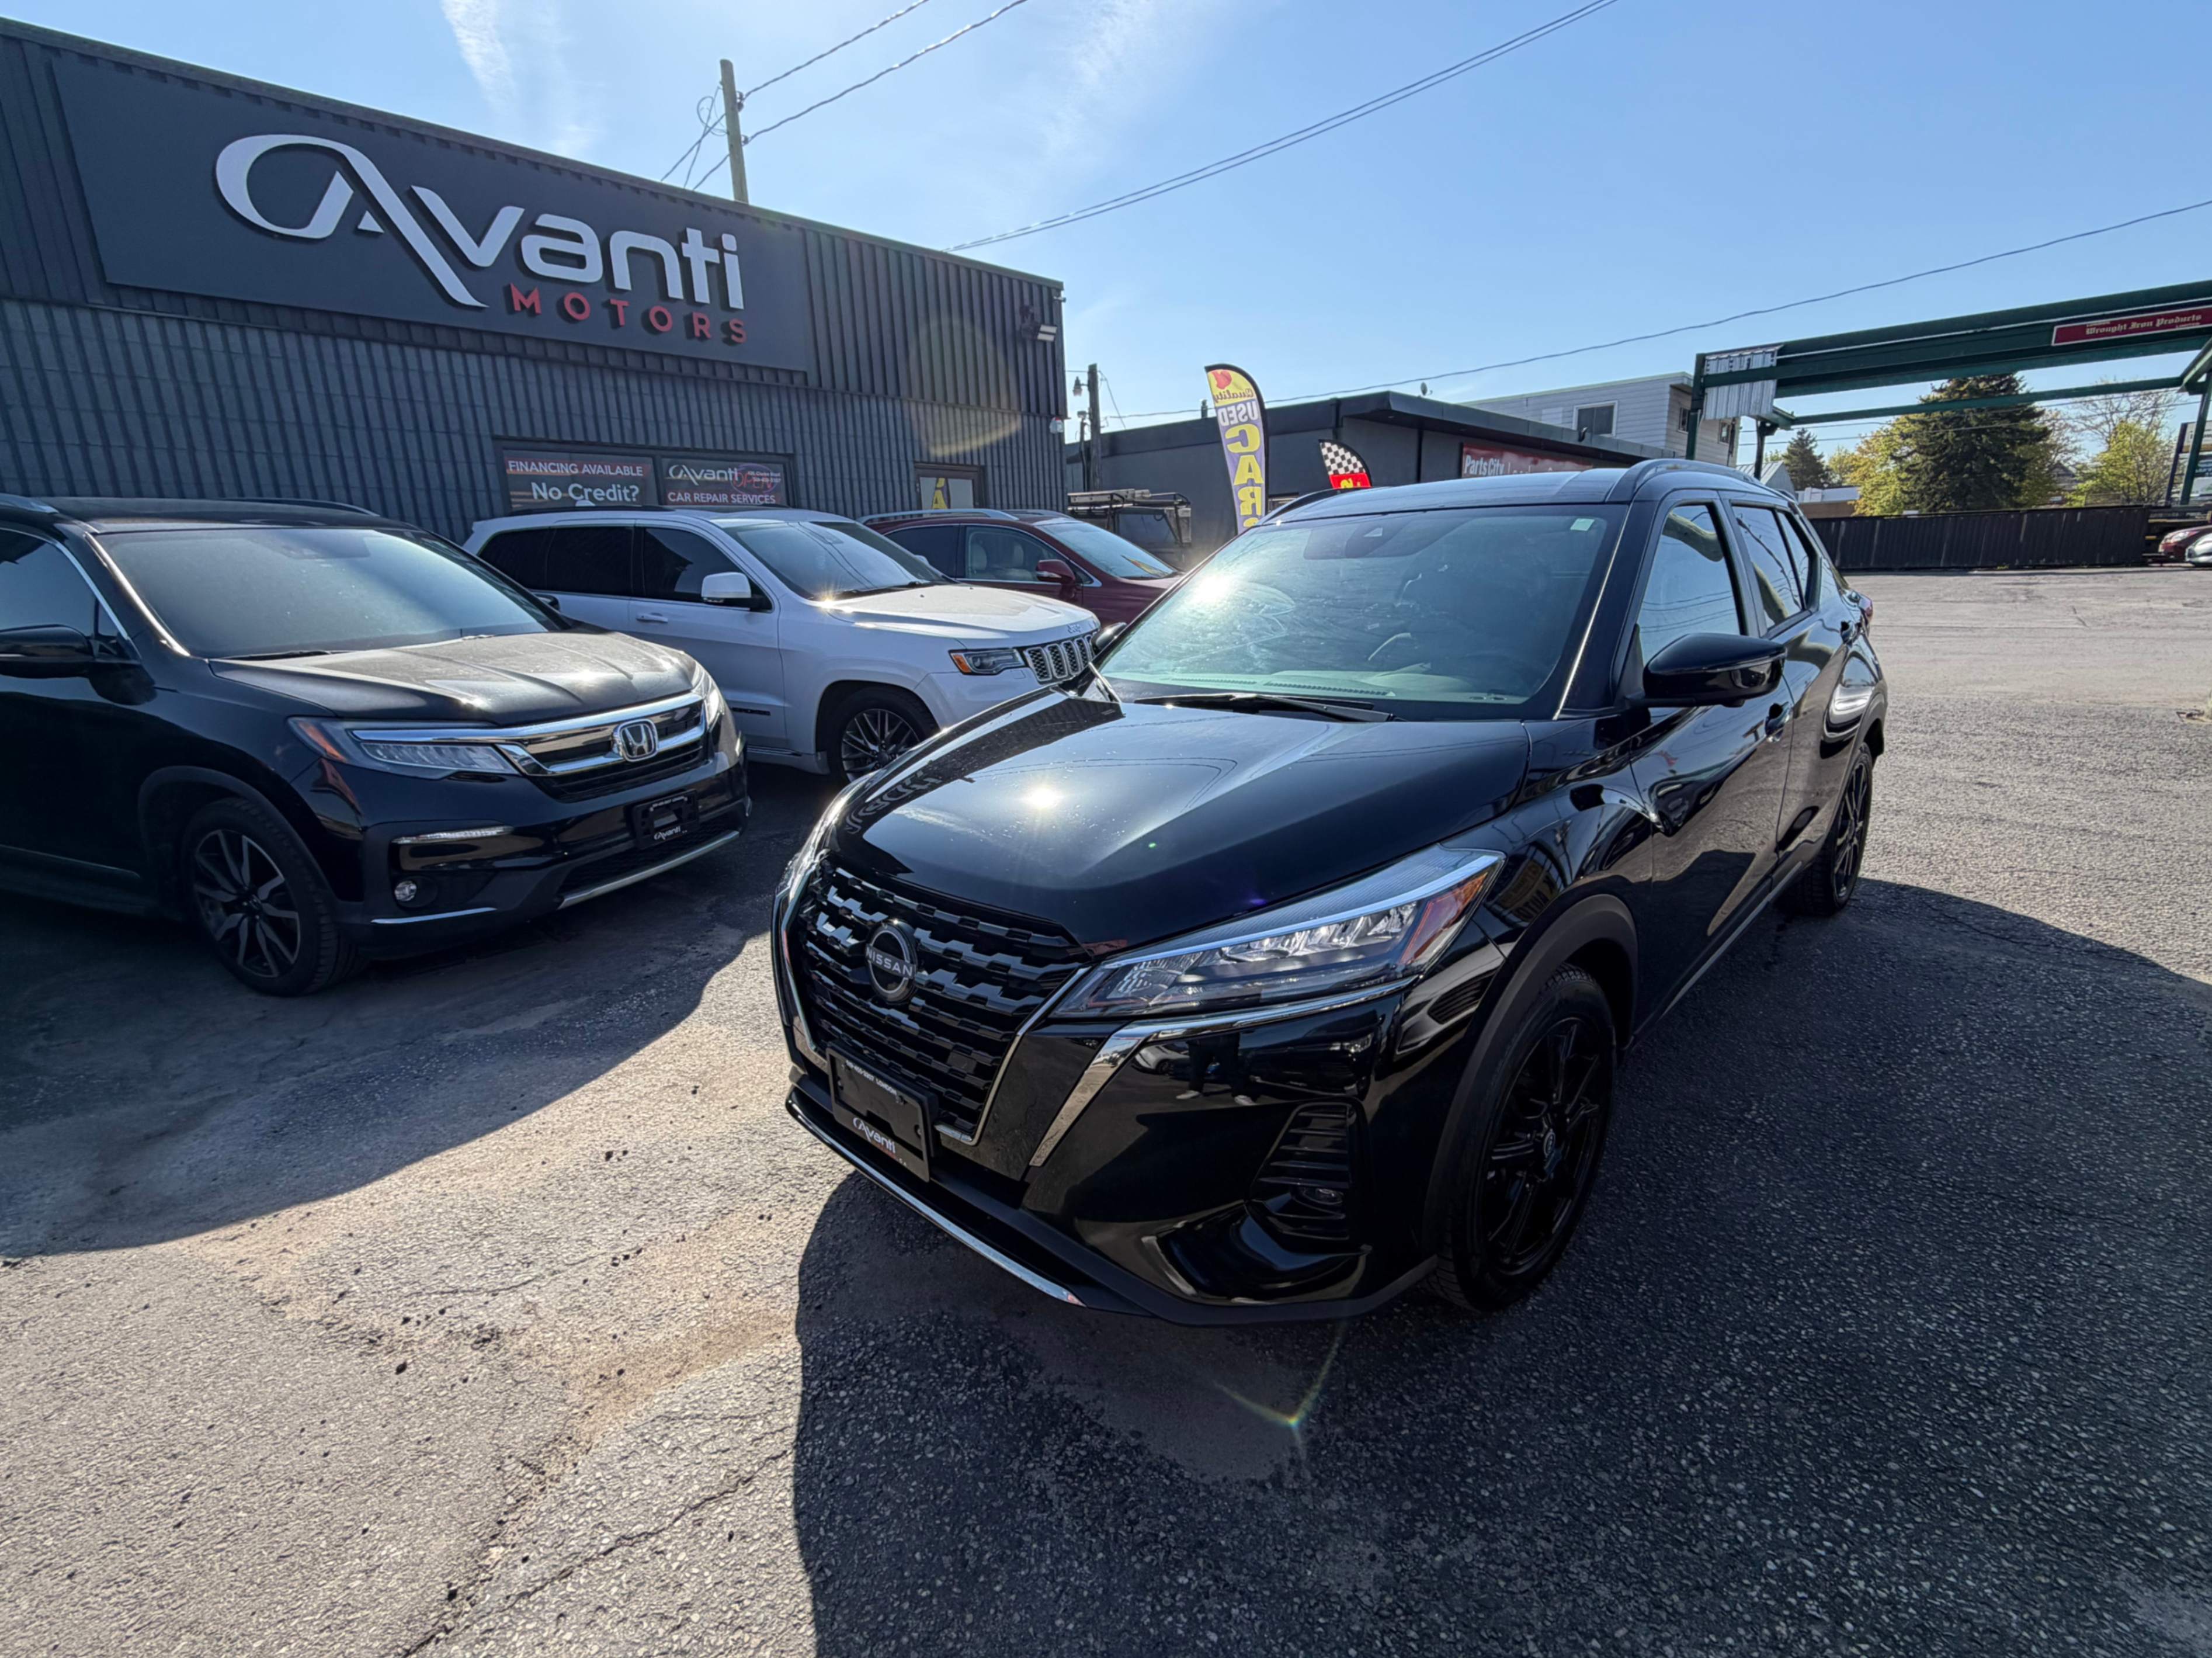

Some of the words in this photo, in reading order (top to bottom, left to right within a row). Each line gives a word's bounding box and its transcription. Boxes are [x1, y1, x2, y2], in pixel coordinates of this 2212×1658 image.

[215, 134, 745, 310] Avanti
[510, 283, 748, 343] MOTORS
[2086, 322, 2127, 335] Wrought
[2128, 320, 2153, 330] Iron
[2155, 314, 2201, 327] Products
[508, 460, 579, 474] FINANCING
[582, 464, 643, 476] AVAILABLE
[668, 464, 738, 486] Avanti
[531, 482, 562, 500] No
[568, 483, 640, 502] Credit?
[668, 492, 691, 502] CAR
[694, 493, 728, 503] REPAIR
[731, 494, 776, 504] SERVICES
[654, 825, 681, 841] Avanti
[866, 946, 913, 977] NISSAN
[853, 1116, 896, 1154] Avanti
